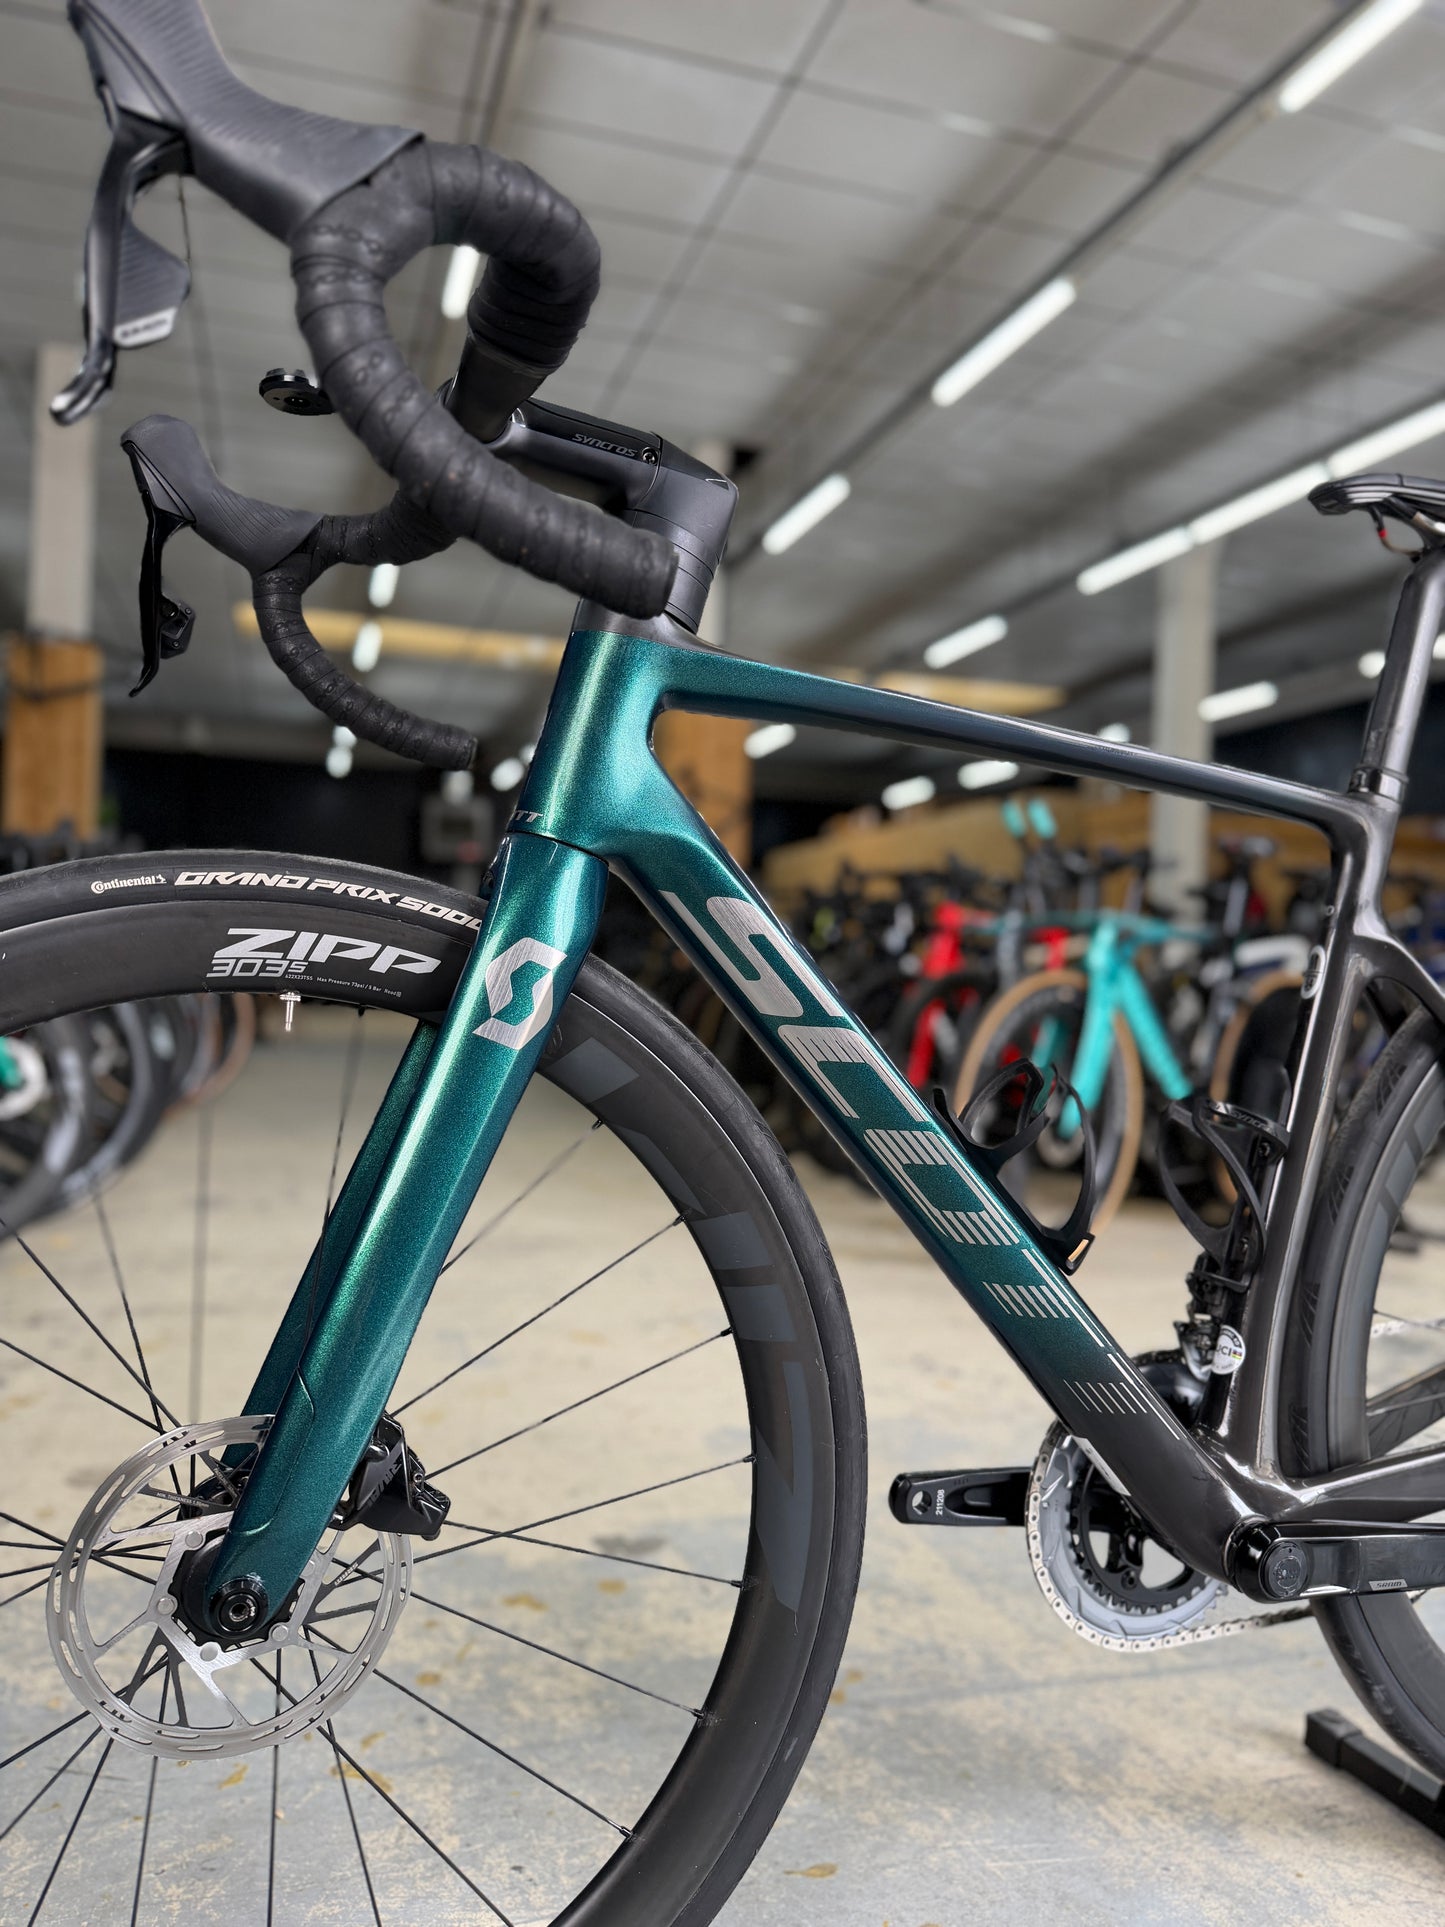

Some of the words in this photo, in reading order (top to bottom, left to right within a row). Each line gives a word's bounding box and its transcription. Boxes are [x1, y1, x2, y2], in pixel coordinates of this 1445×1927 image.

[90, 874, 157, 894] Continental
[174, 871, 310, 889] GRAND
[307, 878, 400, 904] PRIX
[213, 928, 442, 974] ZIPP
